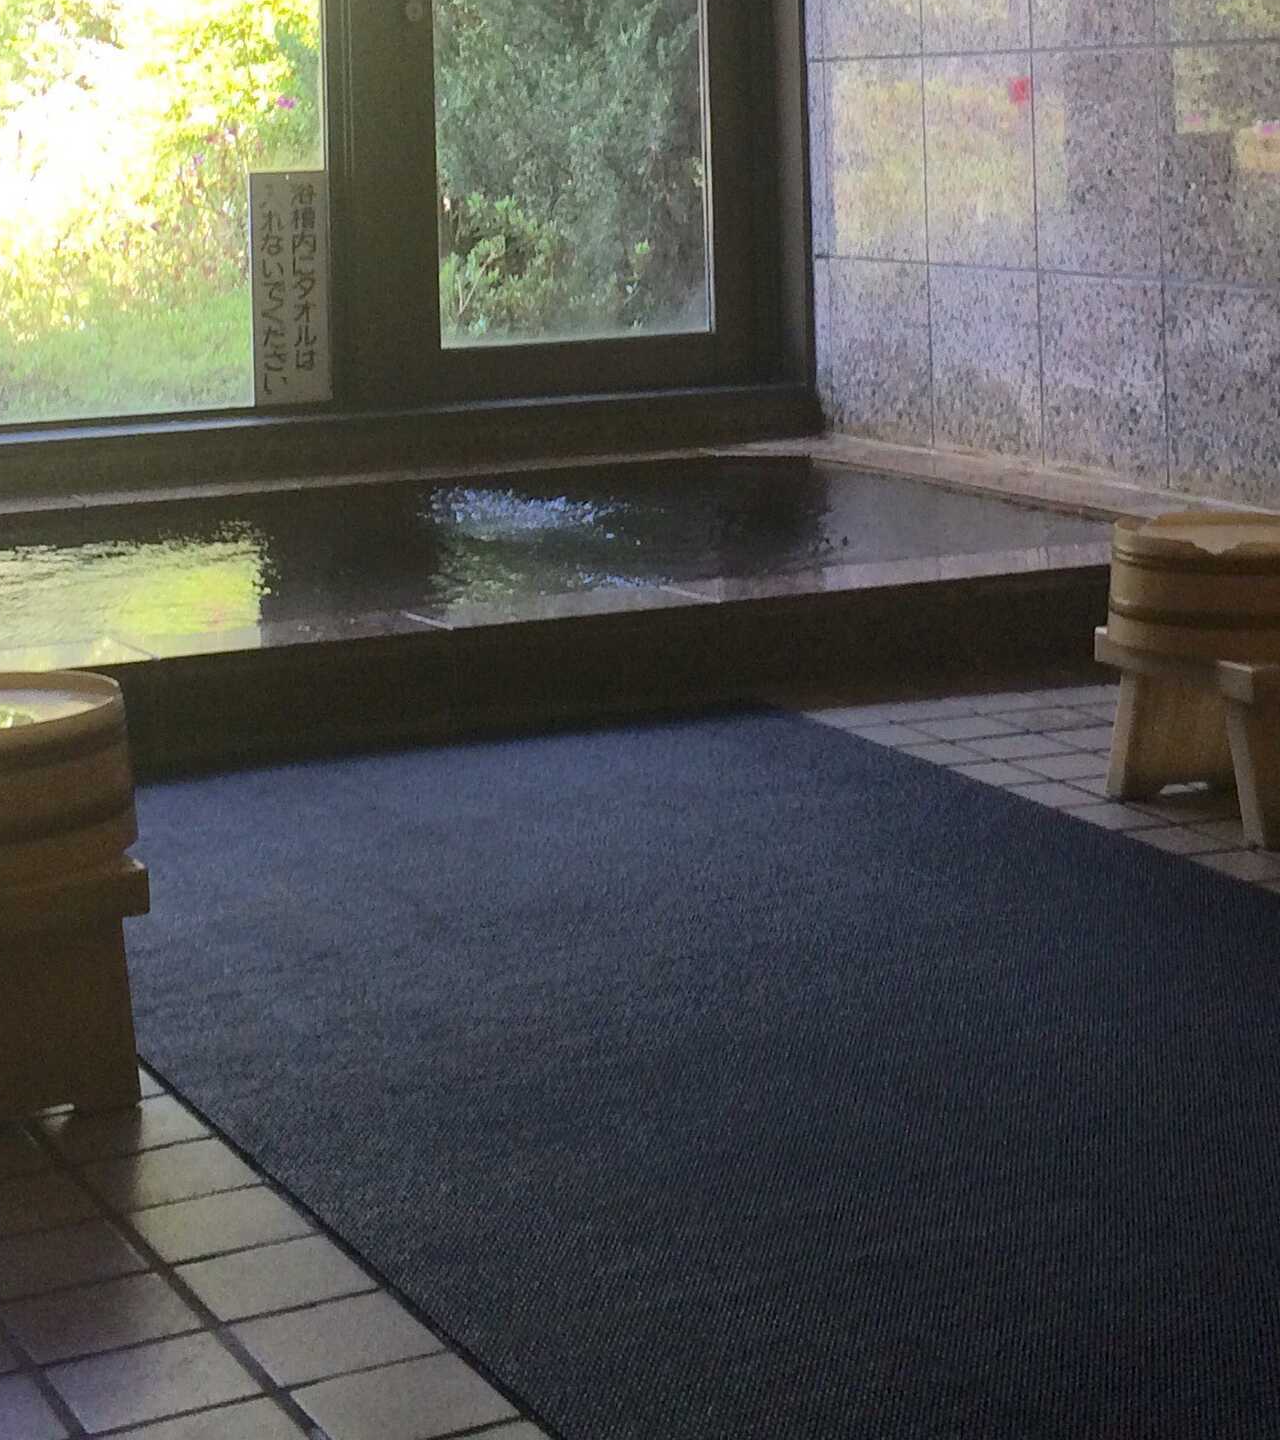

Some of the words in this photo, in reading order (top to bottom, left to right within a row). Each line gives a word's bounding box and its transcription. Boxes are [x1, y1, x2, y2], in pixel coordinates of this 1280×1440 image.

[289, 182, 318, 371] 浴槽内にタオルは
